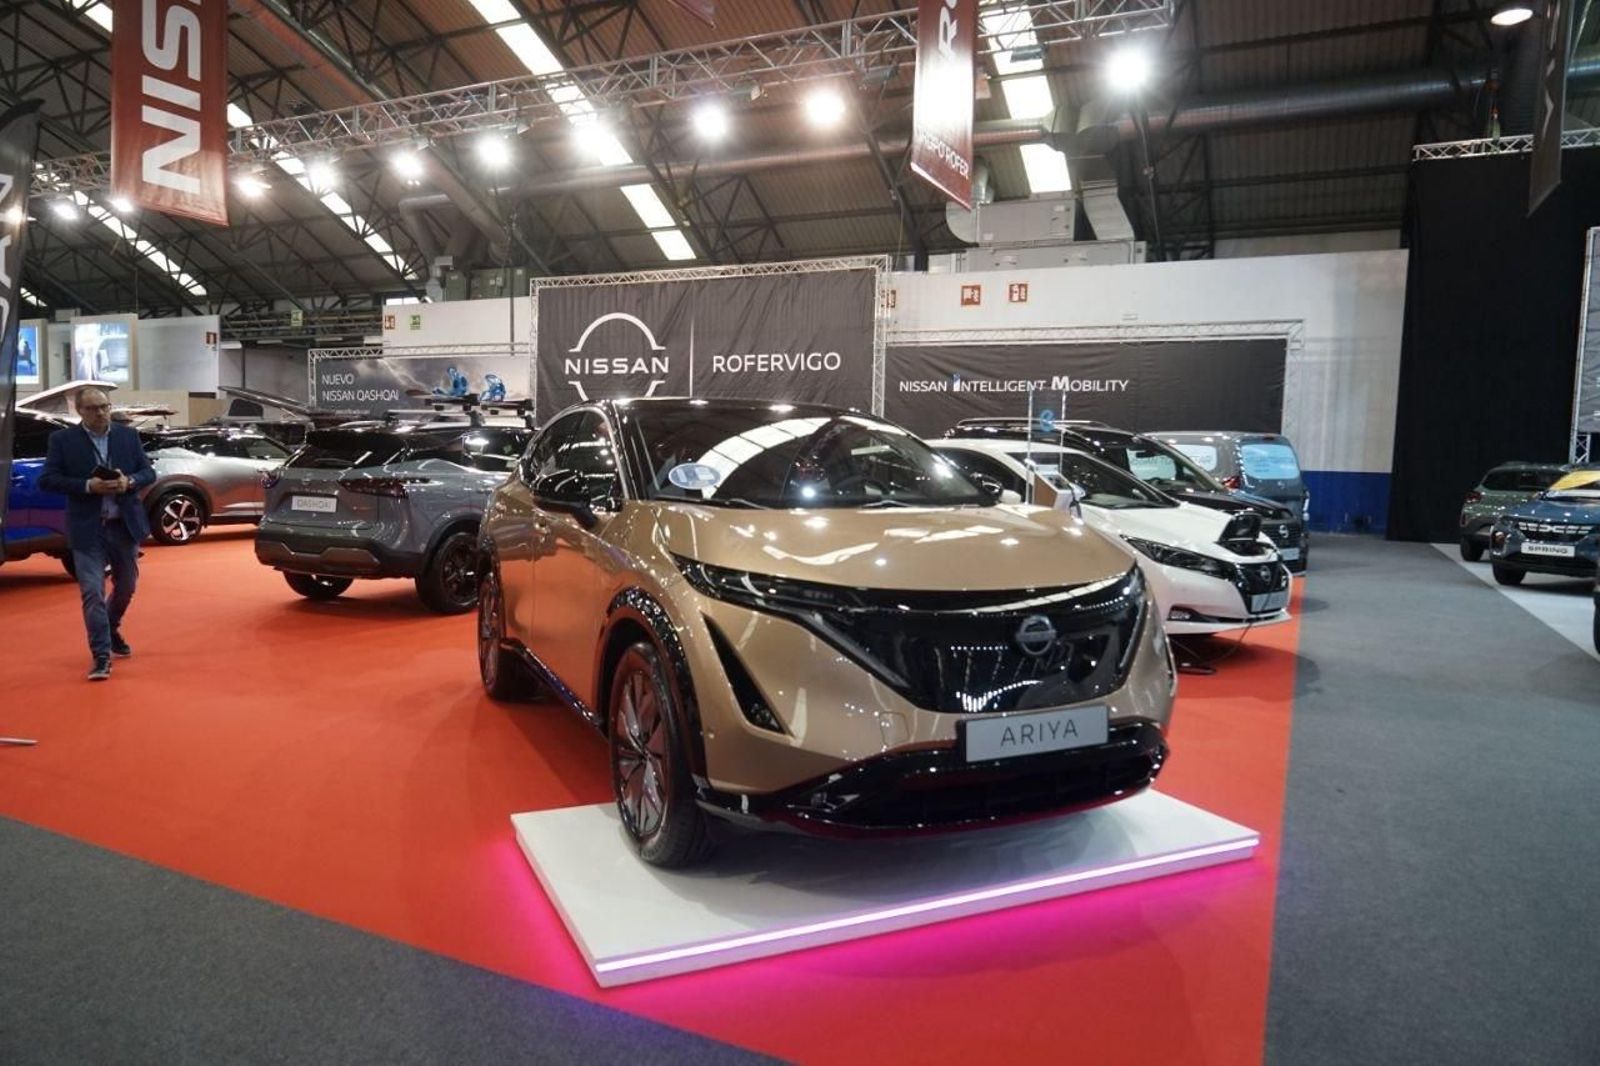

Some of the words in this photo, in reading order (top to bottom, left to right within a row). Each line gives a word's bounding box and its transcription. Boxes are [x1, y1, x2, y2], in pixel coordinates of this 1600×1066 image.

[141, 0, 201, 195] NIS
[565, 356, 669, 375] NISSAN
[713, 352, 841, 373] ROFERVIGO
[322, 374, 354, 385] NUEVO
[900, 380, 947, 392] NISSAN
[1051, 375, 1129, 392] MOBILITY
[322, 390, 356, 402] NISSAN
[357, 389, 399, 402] QASHQAI
[1528, 545, 1568, 554] SPRING
[1000, 719, 1078, 747] ARIYA
